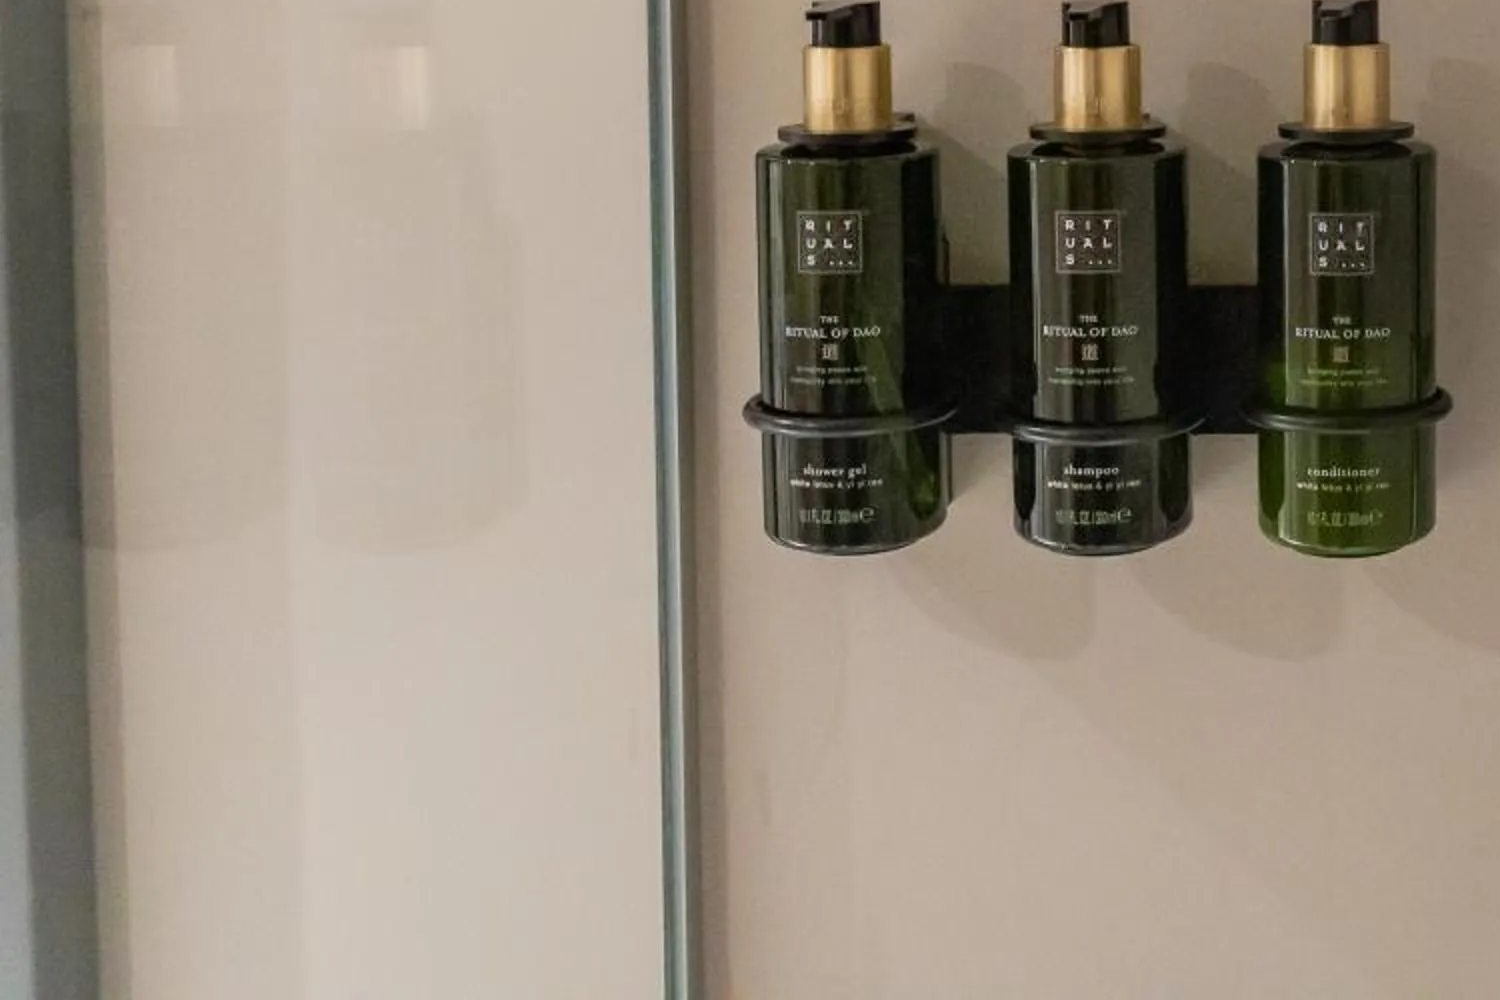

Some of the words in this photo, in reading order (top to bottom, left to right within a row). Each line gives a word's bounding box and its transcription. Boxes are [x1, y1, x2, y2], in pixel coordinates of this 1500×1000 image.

[820, 315, 840, 324] THE
[1079, 315, 1099, 324] THE
[1332, 316, 1352, 325] THE
[785, 326, 829, 339] RITUAL
[831, 327, 850, 339] OF
[853, 325, 881, 338] DAO
[1043, 325, 1087, 338] RITUAL
[1089, 327, 1109, 338] OF
[1111, 325, 1138, 338] DAO
[1295, 327, 1340, 340] RITUAL
[1343, 328, 1361, 340] OF
[1364, 327, 1391, 339] DAO
[803, 463, 845, 477] shower
[847, 463, 867, 479] gel
[1064, 463, 1119, 479] shampoo
[1307, 466, 1380, 478] conditioner
